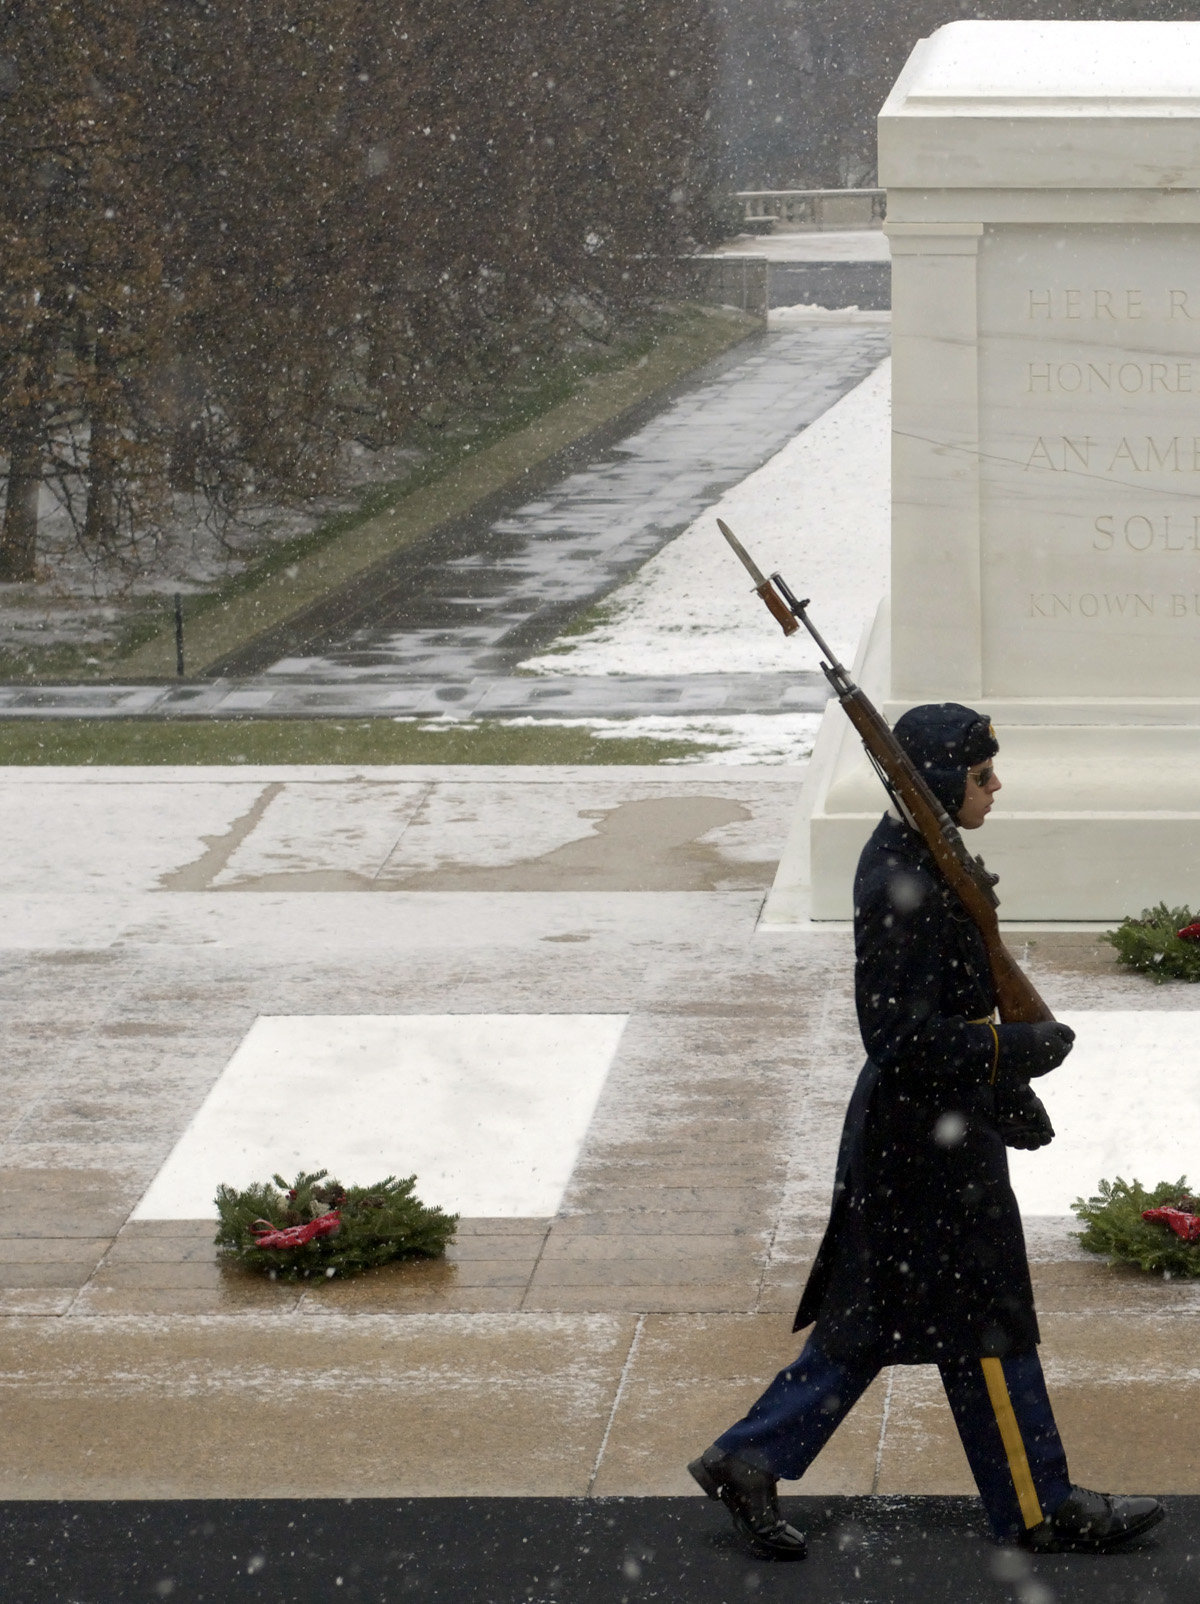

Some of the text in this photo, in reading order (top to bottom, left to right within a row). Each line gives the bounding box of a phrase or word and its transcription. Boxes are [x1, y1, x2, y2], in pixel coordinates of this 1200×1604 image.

[1027, 288, 1143, 320] HERE
[1023, 435, 1091, 472] AN
[1029, 593, 1154, 618] KNOWN
